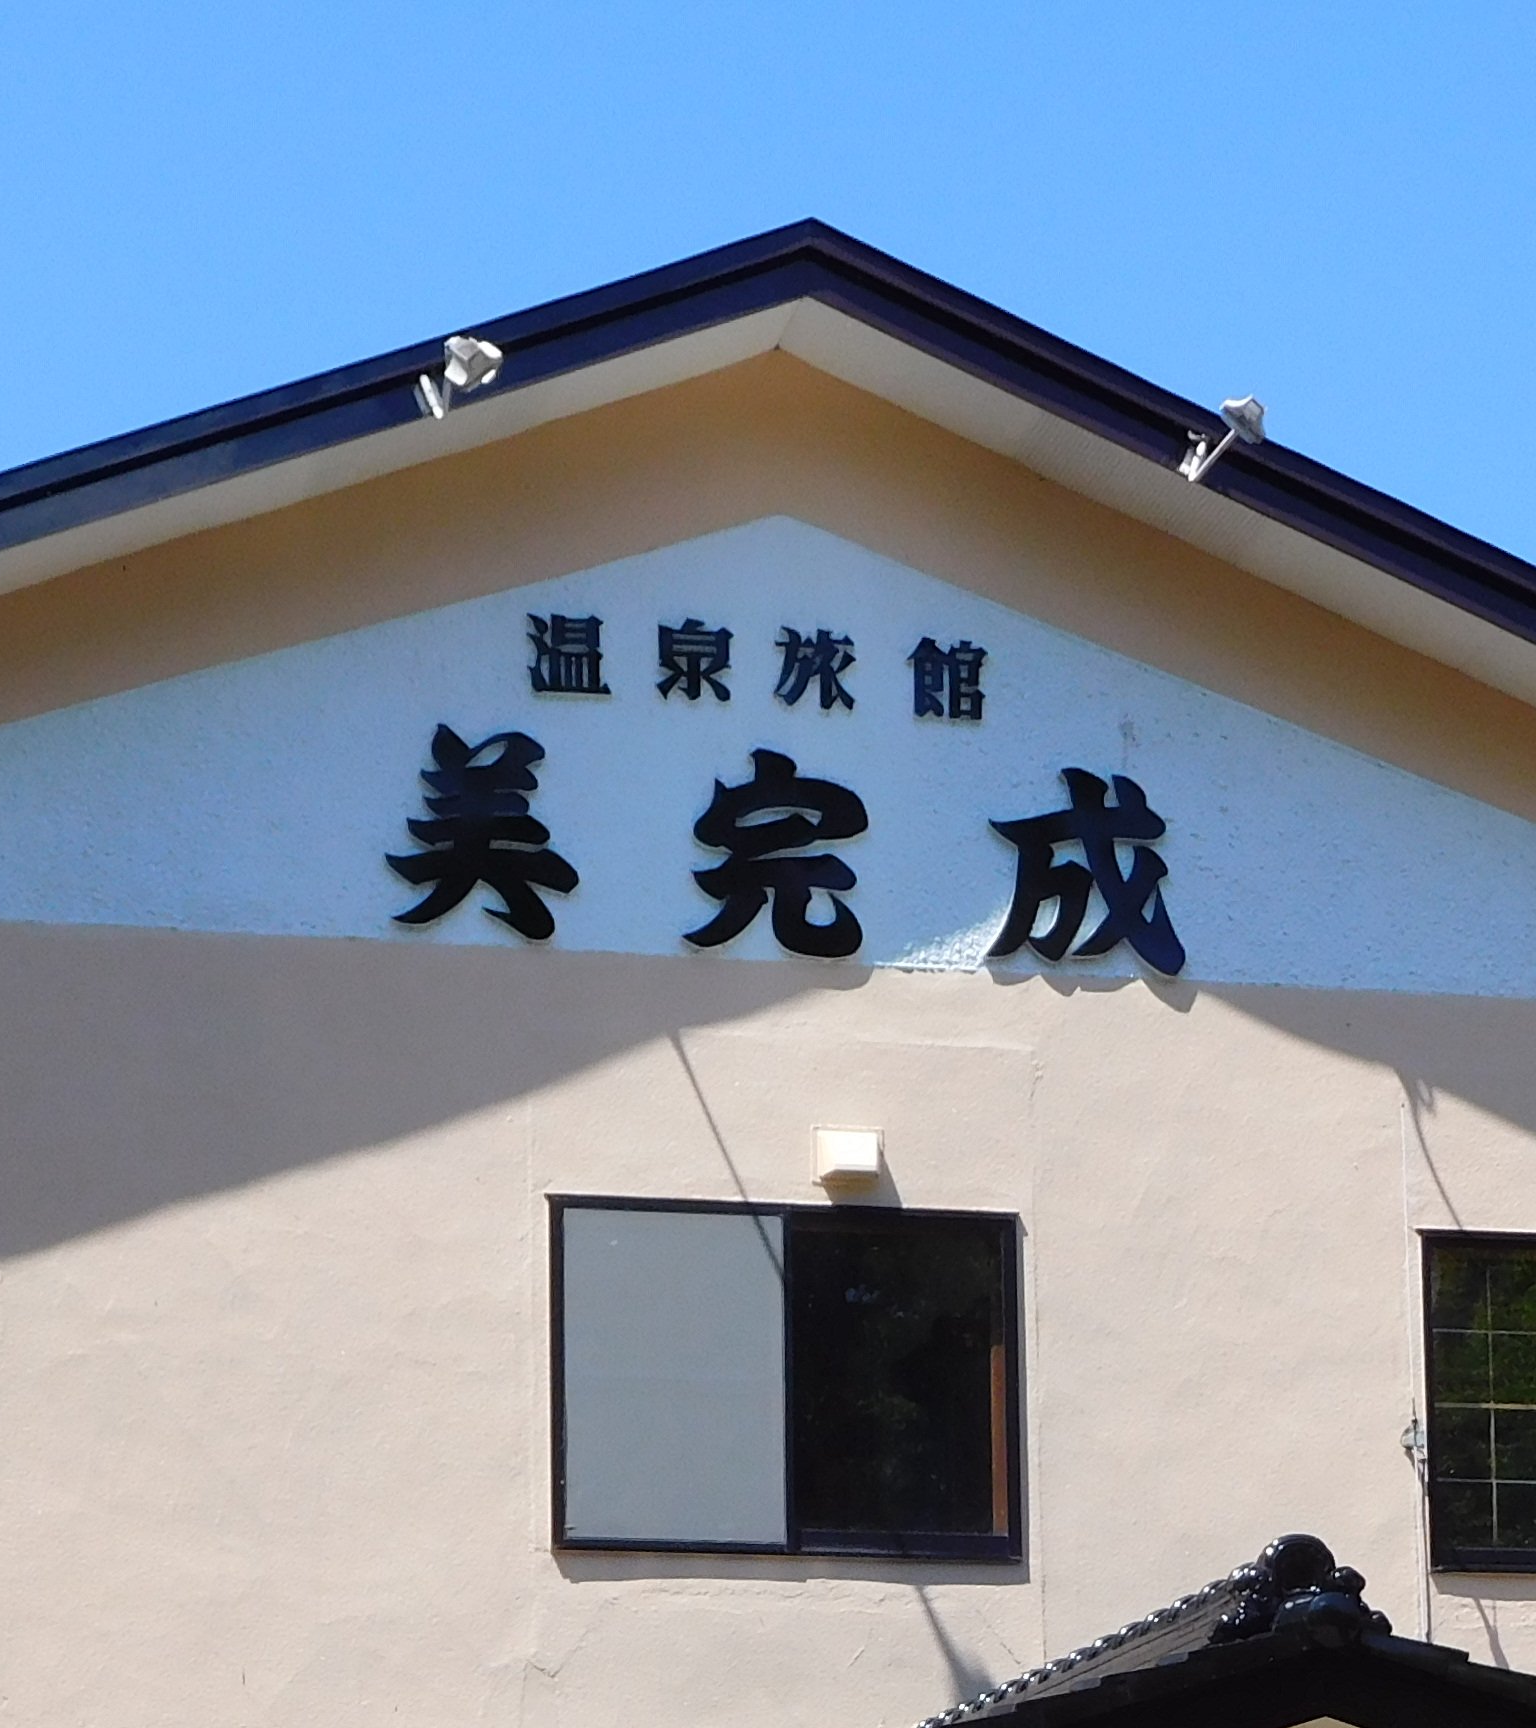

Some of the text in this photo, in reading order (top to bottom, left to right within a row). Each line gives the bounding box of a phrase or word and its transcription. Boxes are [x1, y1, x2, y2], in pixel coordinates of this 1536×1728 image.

[526, 613, 990, 722] 温泉旅館
[384, 722, 1186, 978] 美完成
